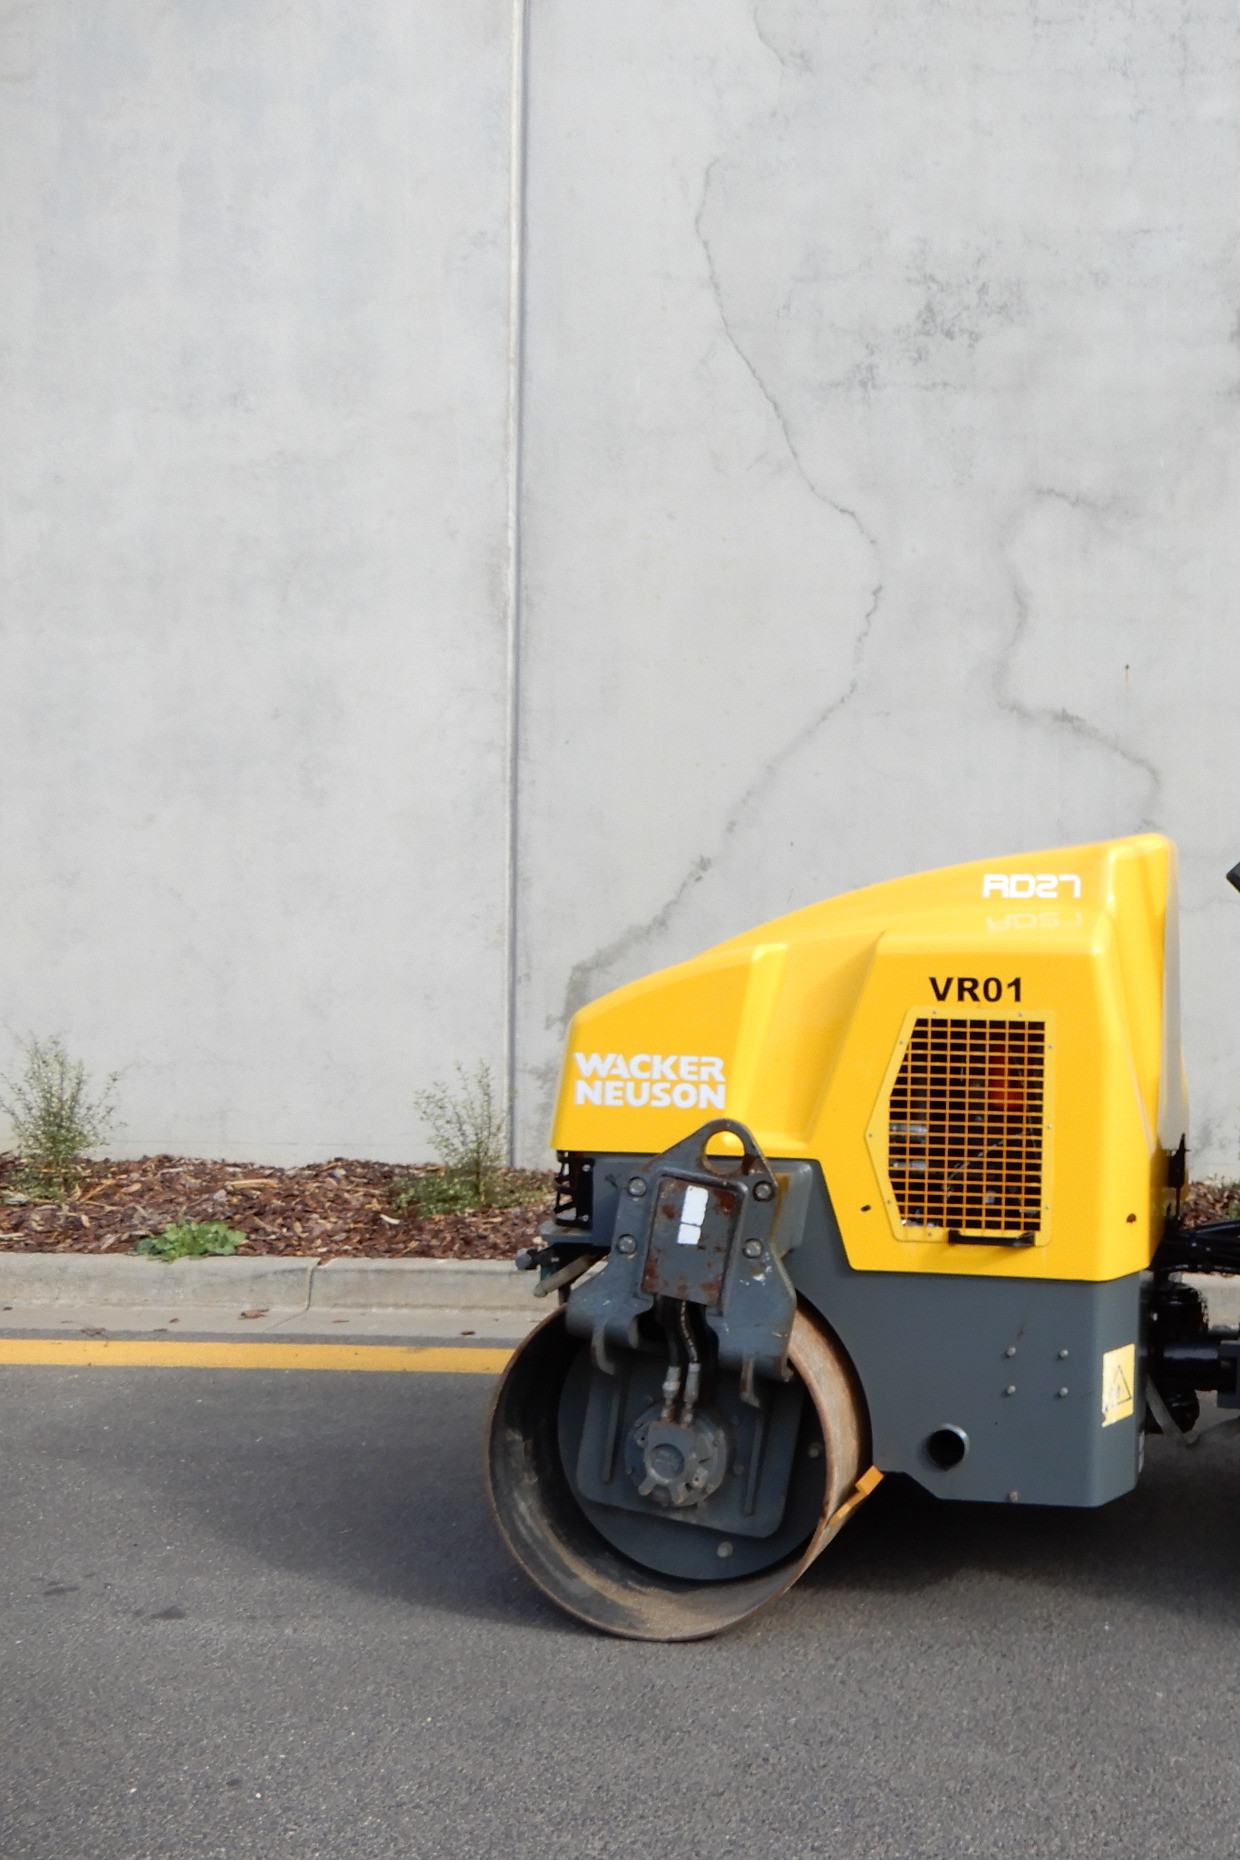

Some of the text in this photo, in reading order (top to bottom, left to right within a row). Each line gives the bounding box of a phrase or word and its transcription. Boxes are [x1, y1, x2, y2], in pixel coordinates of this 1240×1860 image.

[982, 873, 1081, 898] RD27
[928, 976, 1022, 1003] VR01
[573, 1052, 727, 1082] WACKER
[574, 1079, 726, 1110] NEUSON
